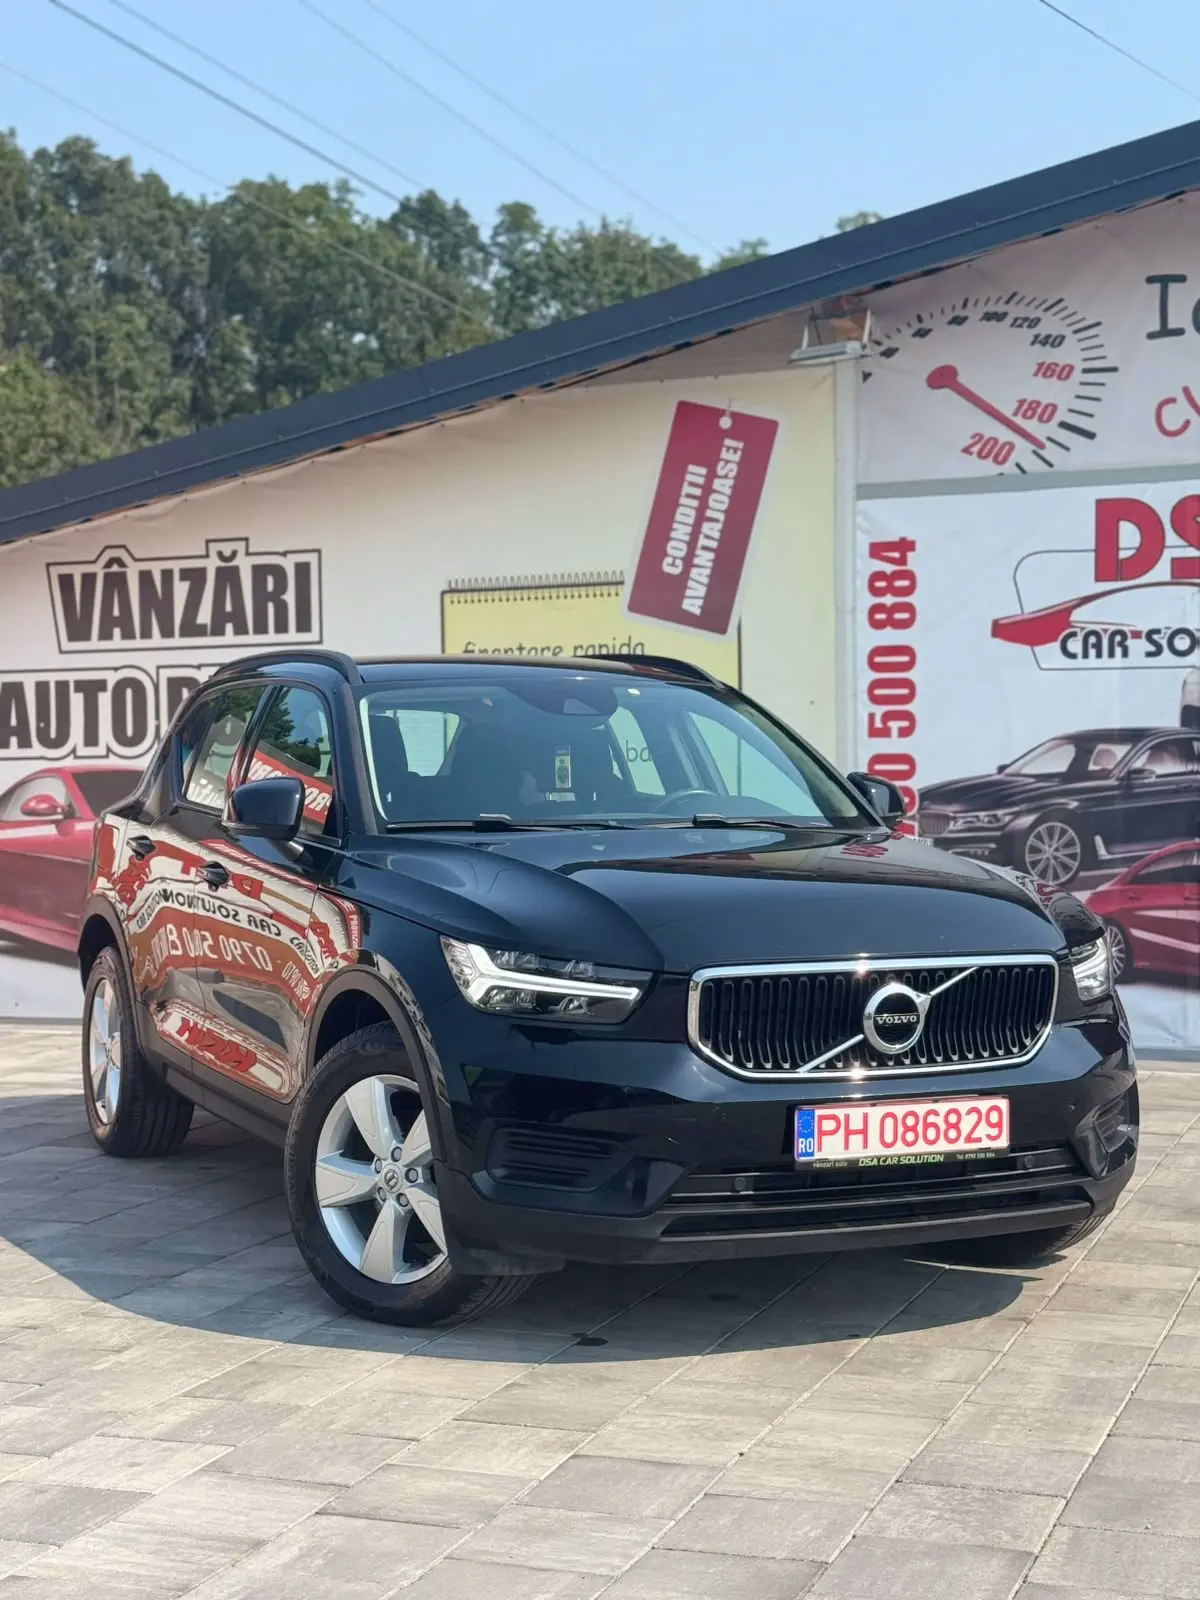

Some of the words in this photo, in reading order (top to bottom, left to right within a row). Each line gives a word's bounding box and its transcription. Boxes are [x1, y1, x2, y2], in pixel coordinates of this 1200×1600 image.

[1009, 316, 1041, 329] 120
[1145, 274, 1200, 340] I
[1030, 333, 1066, 348] 140
[1032, 361, 1075, 382] 160
[1012, 398, 1058, 424] 180
[960, 432, 1016, 466] 200
[662, 464, 708, 575] CONDITII
[681, 438, 744, 616] AVANTAJOASE!
[58, 549, 313, 642] VÂNZĂRI
[868, 537, 917, 630] 884
[1060, 629, 1129, 660] CAR
[867, 645, 917, 738] 500
[0, 676, 148, 750] AUTO
[875, 1015, 917, 1025] VOLVO
[799, 1138, 814, 1152] RO
[817, 1112, 868, 1152] PH
[879, 1105, 1003, 1148] 086829
[858, 1158, 877, 1167] DSA
[879, 1156, 898, 1166] CAR
[899, 1154, 944, 1165] SOLUTION
